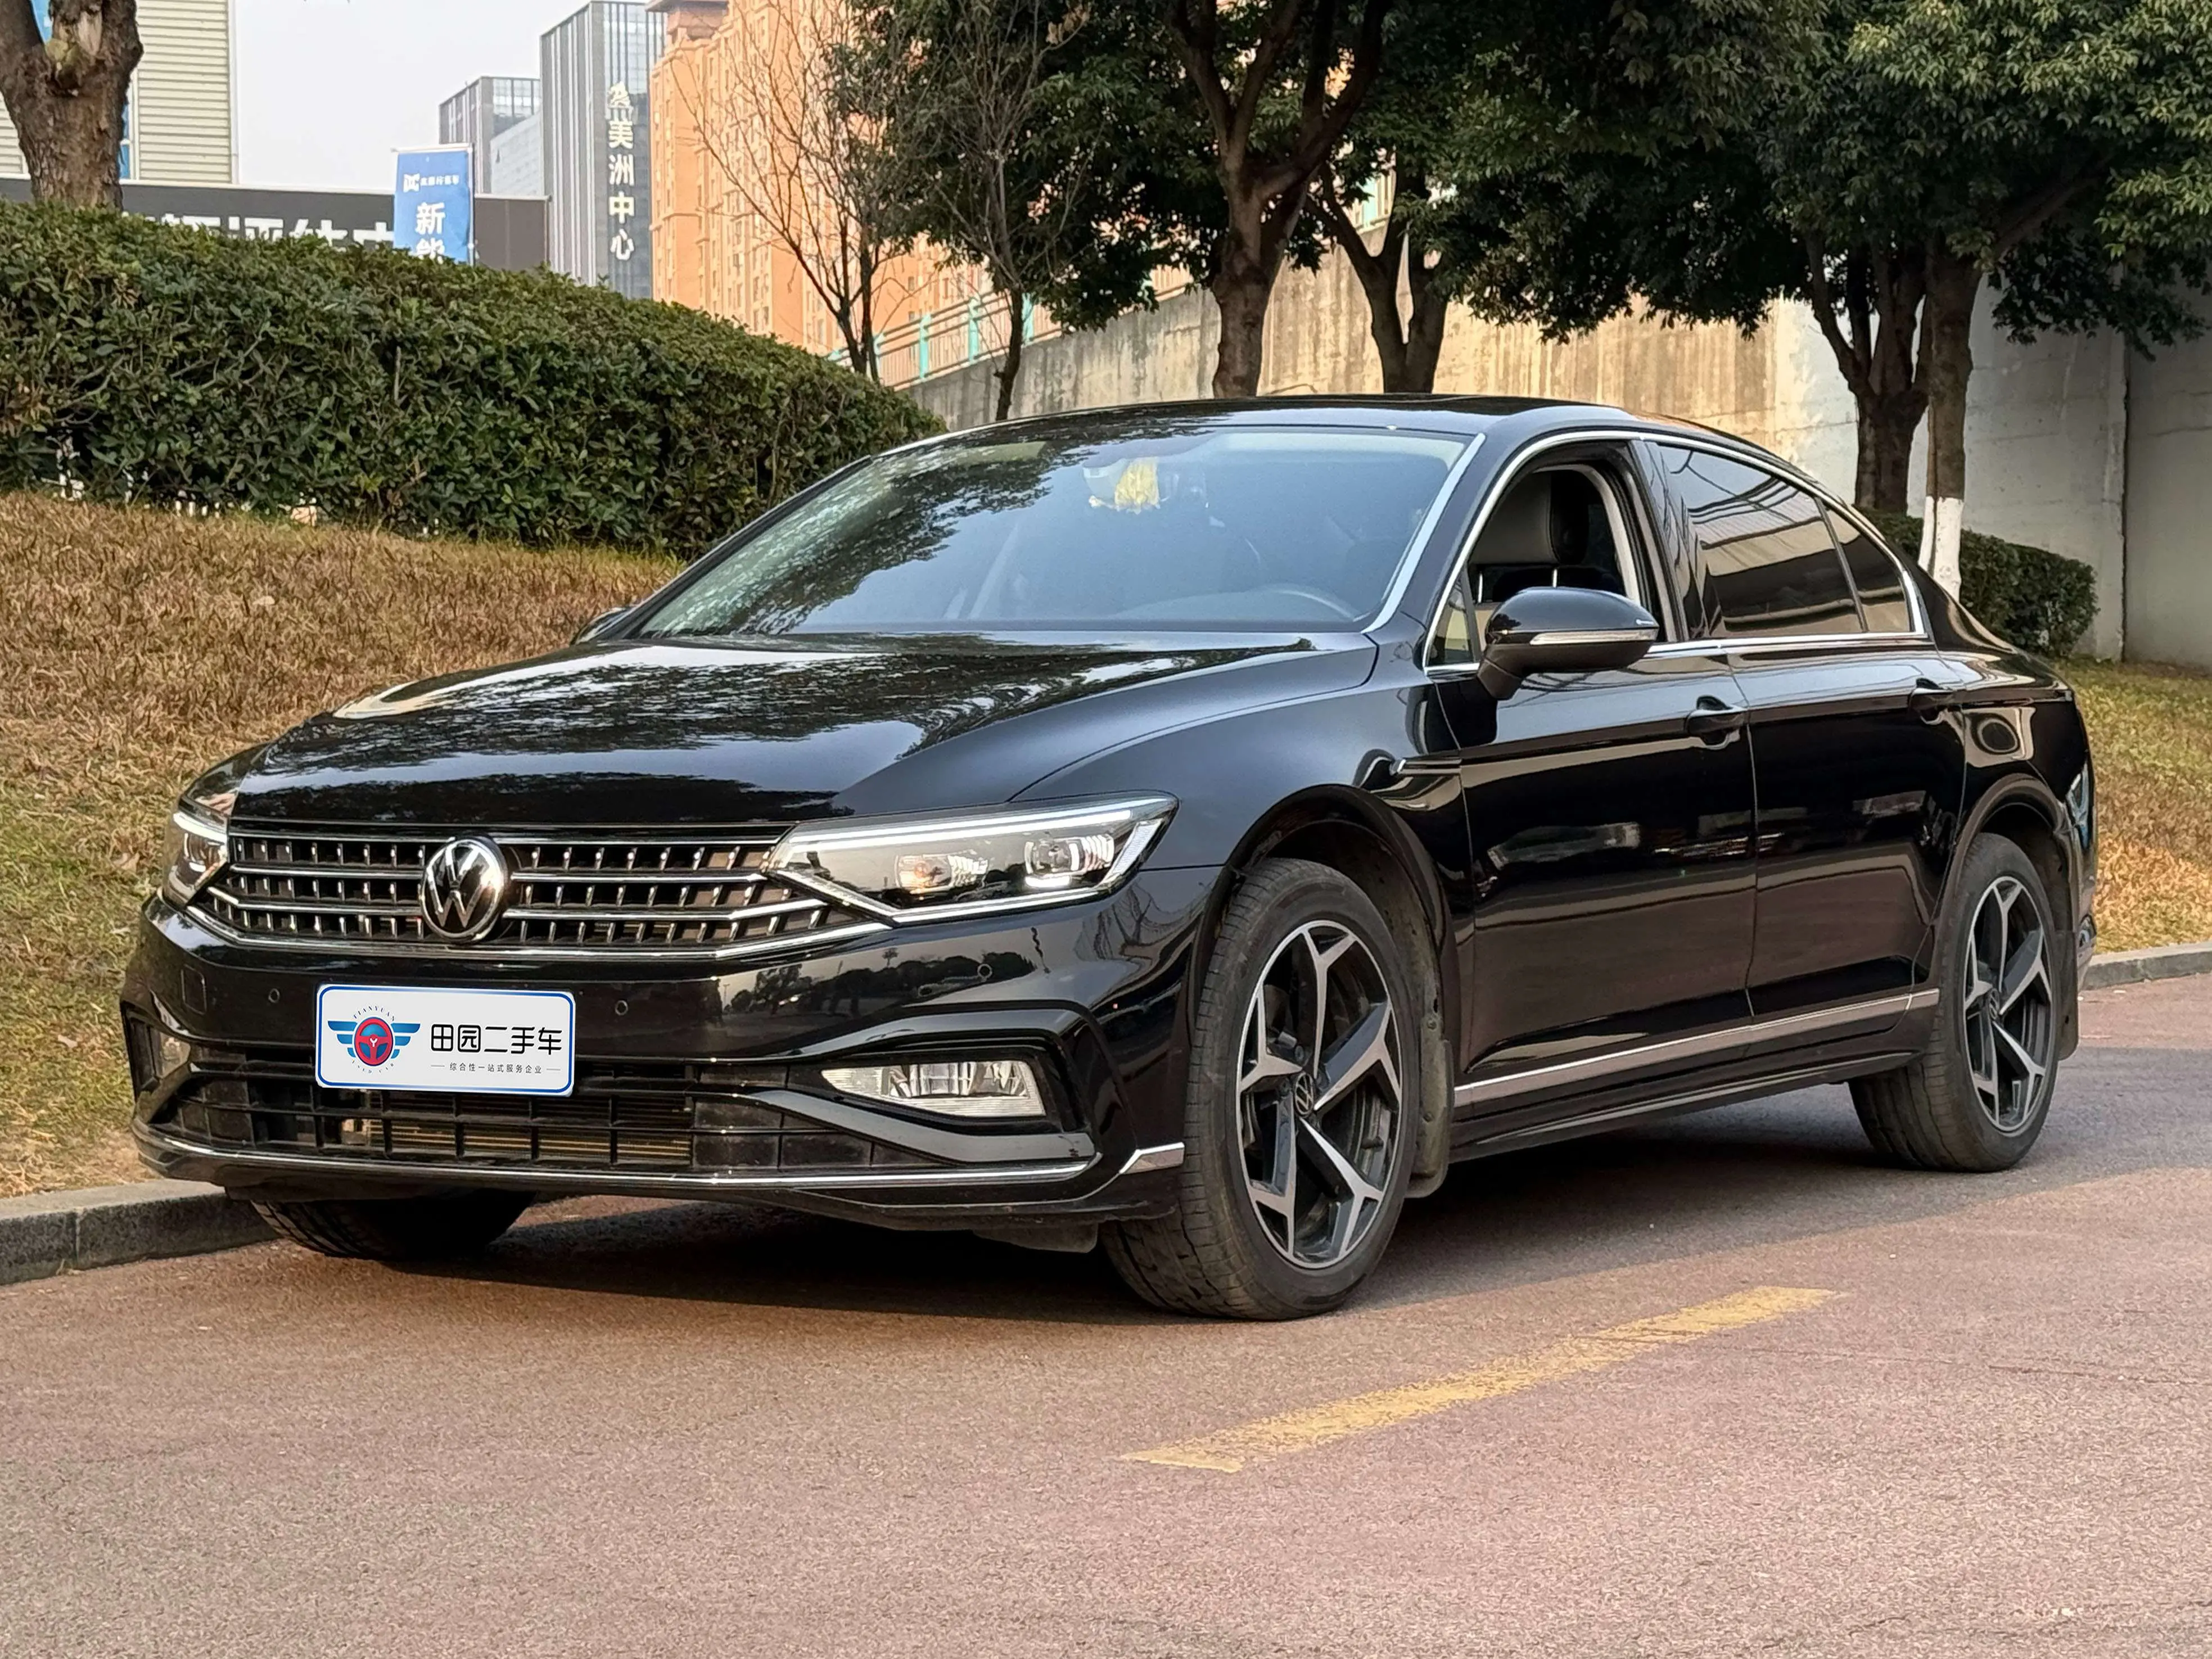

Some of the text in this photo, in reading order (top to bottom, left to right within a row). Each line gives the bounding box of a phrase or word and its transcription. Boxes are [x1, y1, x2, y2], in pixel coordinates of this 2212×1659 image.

[431, 1024, 562, 1055] 田园二手车
[449, 1062, 542, 1074] 综合性一站式服务企业
